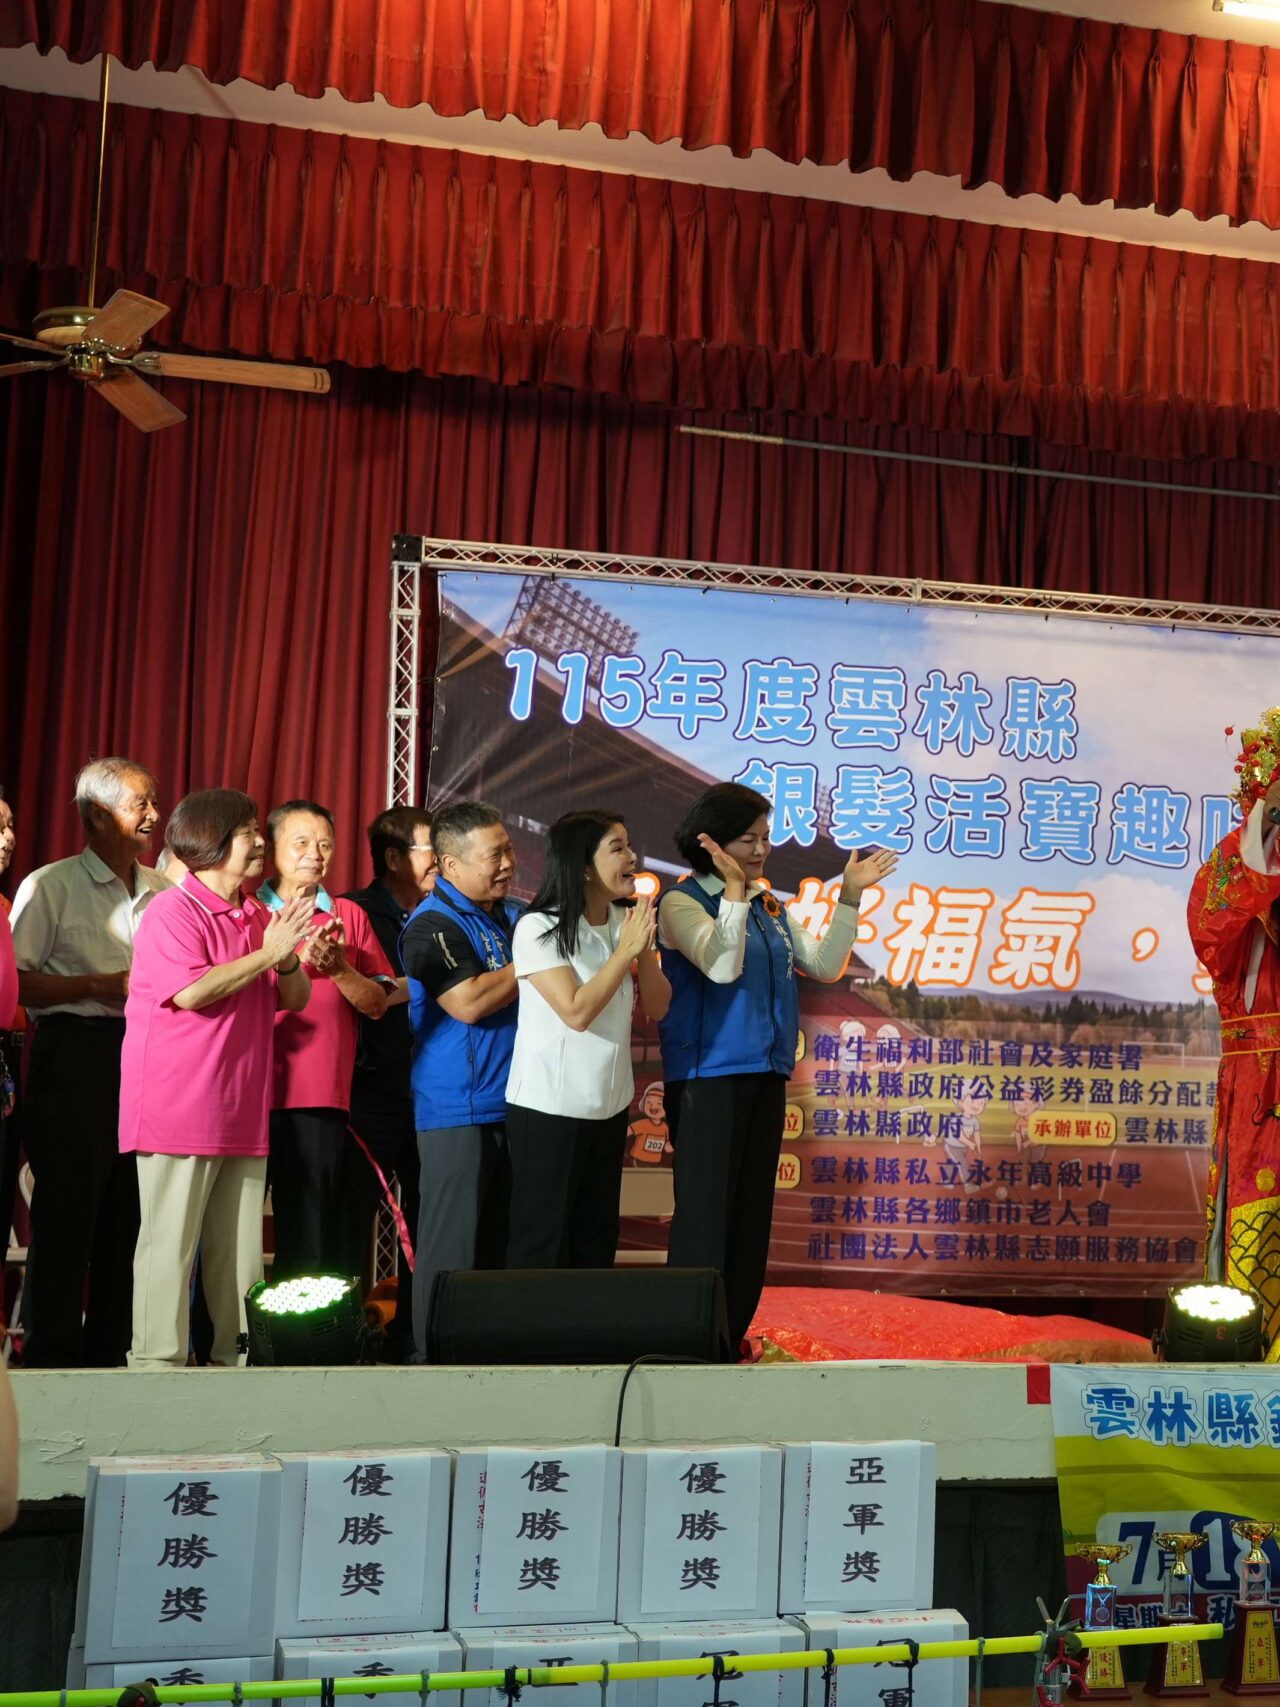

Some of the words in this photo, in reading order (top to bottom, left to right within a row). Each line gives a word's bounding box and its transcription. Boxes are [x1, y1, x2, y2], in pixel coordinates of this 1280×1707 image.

[504, 648, 1078, 763] 115年度雲林縣
[814, 1033, 1143, 1071] 衛生福利部社會及家庭署
[647, 1141, 662, 1150] 202
[812, 1108, 963, 1140] 雲林縣政府
[1033, 1118, 1113, 1140] 承辦單位
[810, 1155, 1143, 1188] 雲林縣私立永年高級中學
[807, 1232, 1198, 1265] 社團法人雲林縣志願服務協會
[810, 1197, 1112, 1227] 雲林縣各鄉鎮市老人會
[157, 1480, 220, 1623] 優勝獎
[338, 1463, 394, 1596] 優勝獎
[515, 1460, 570, 1591] 優勝獎
[676, 1461, 728, 1590] 優勝獎
[841, 1456, 887, 1584] 亞軍獎
